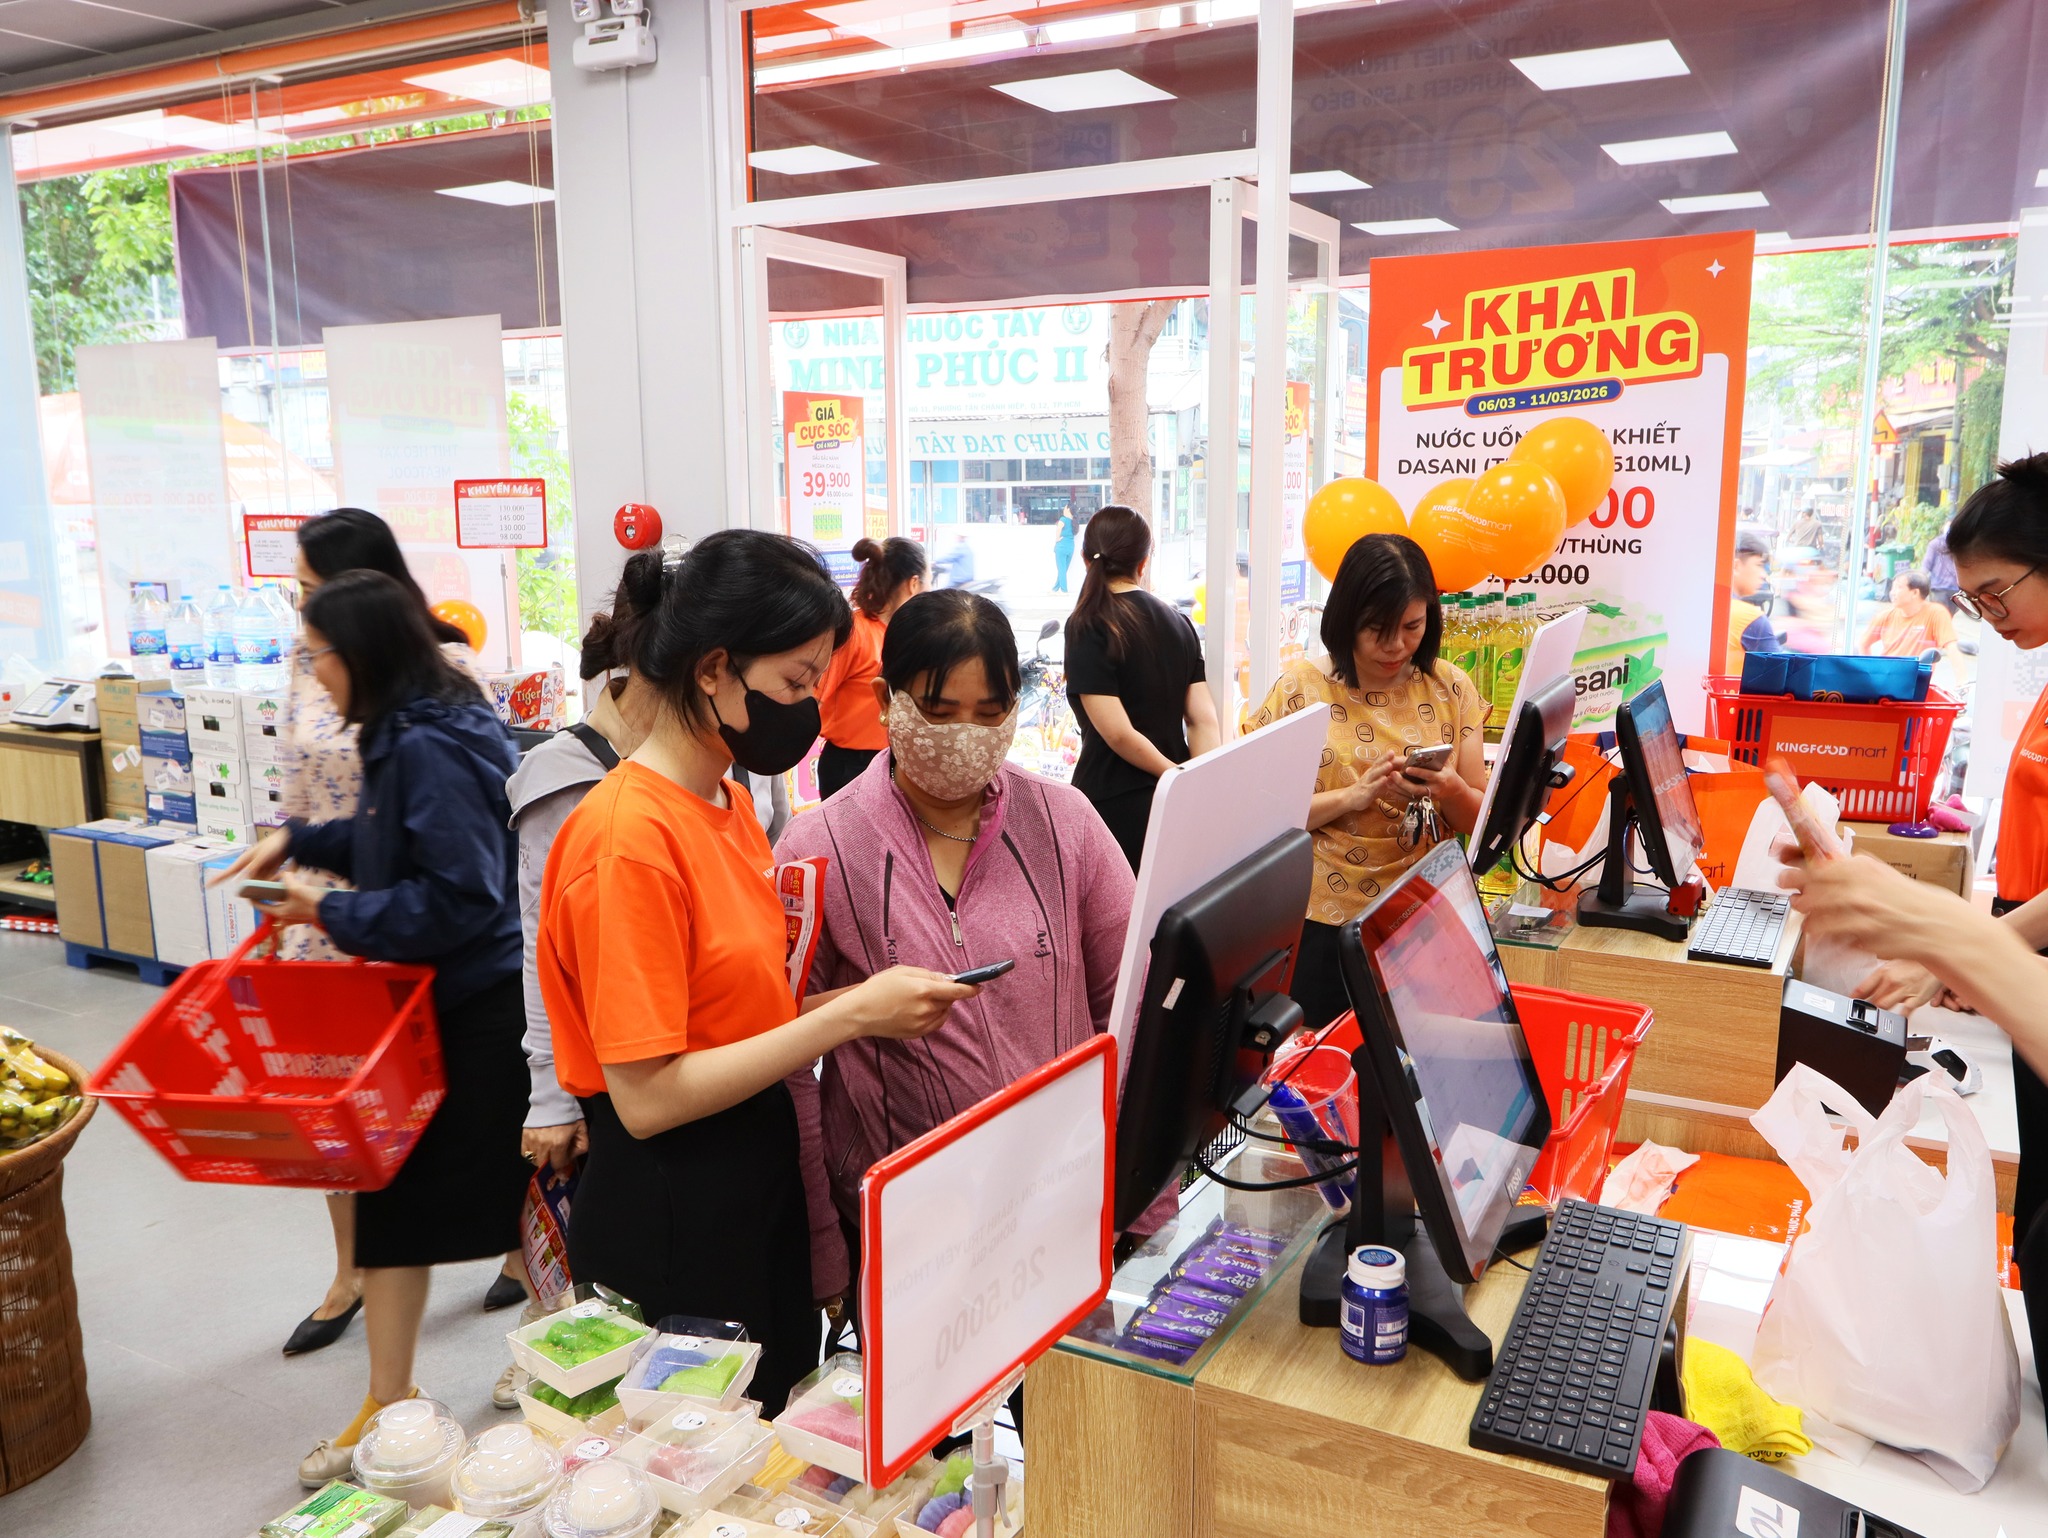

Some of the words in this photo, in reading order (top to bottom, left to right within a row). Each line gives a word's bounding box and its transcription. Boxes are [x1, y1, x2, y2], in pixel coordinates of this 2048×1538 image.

[1470, 276, 1628, 340] KHAI
[916, 340, 1039, 389] PHÚC
[1052, 345, 1089, 383] II
[1408, 318, 1692, 396] TRƯƠNG
[1477, 396, 1516, 412] 06/03
[1530, 385, 1608, 407] 11/03/2026
[815, 402, 835, 422] GIÁ
[800, 424, 825, 444] CỰC
[828, 417, 850, 438] SỐC
[915, 430, 957, 455] TÂY
[962, 433, 1008, 458] ĐẠT
[1013, 419, 1090, 453] CHUẨN
[1416, 427, 1476, 449] NƯỚC
[1482, 424, 1526, 448] UỐN
[1612, 420, 1681, 445] KHIẾT
[1397, 457, 1476, 475] DASANI
[467, 482, 511, 497] KHUYẾN
[512, 483, 534, 497] MÃI
[803, 472, 851, 497] 39.900
[256, 517, 297, 531] KHUYẾN
[1555, 534, 1643, 555] /THÙNG
[1575, 657, 1630, 695] sani
[515, 687, 542, 706] Tiger
[1775, 741, 1888, 759] KINGFOODmart
[1220, 1275, 1255, 1289] AIRY
